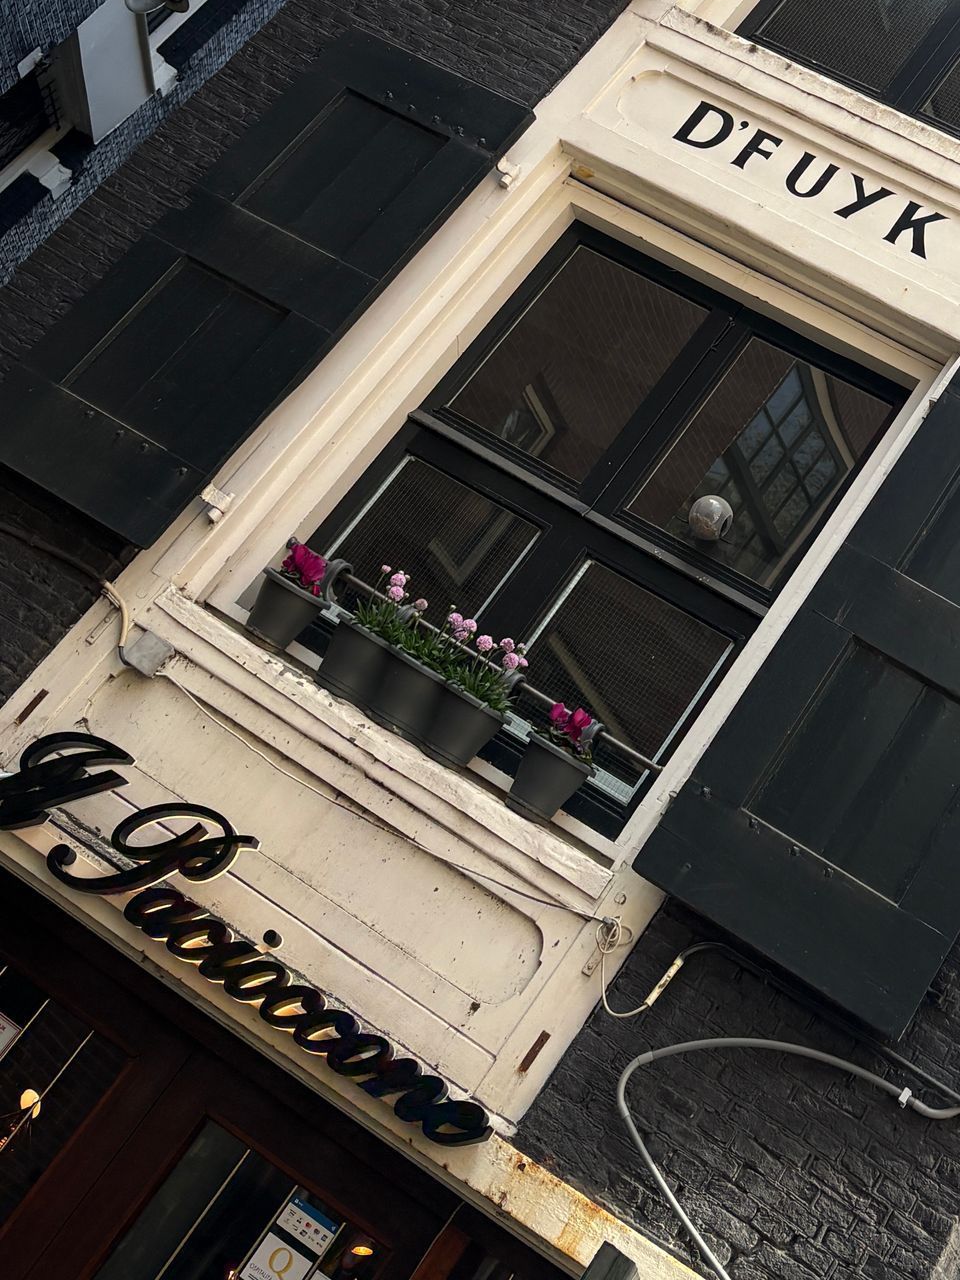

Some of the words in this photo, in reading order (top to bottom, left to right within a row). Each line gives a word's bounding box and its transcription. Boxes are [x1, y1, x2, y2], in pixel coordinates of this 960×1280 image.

[672, 100, 950, 260] D'FUYK
[47, 803, 495, 1147] Pacioccone
[268, 1247, 293, 1280] Q
